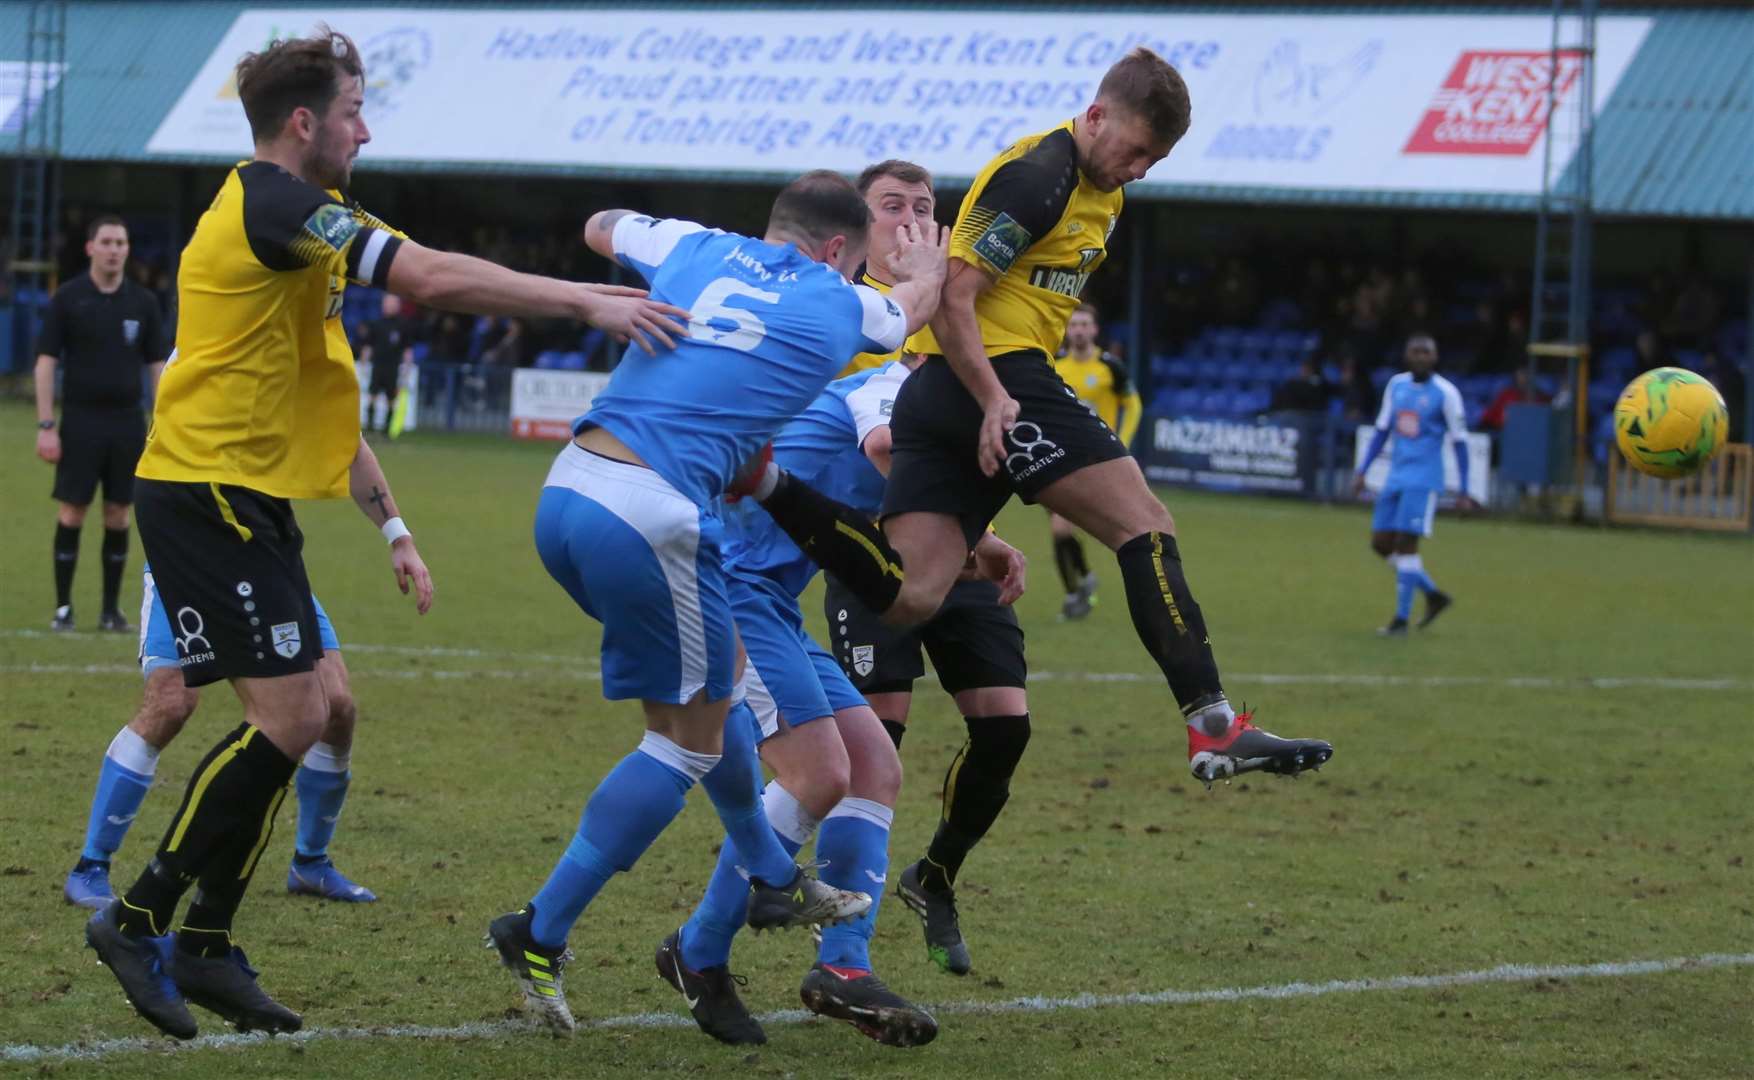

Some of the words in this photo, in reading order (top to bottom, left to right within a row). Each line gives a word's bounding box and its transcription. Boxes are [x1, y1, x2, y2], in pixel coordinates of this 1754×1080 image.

[486, 28, 616, 60] Hadlow
[627, 28, 763, 69] College
[771, 31, 848, 63] and
[852, 30, 953, 65] West
[956, 31, 1057, 66] Kent
[559, 66, 677, 98] Proud
[668, 74, 819, 110] partner
[823, 71, 906, 104] and
[904, 78, 1089, 114] sponsors
[1463, 56, 1584, 88] WEST
[1444, 87, 1564, 122] KENT
[570, 107, 621, 142] of
[624, 108, 812, 153] Tonbridge
[816, 114, 958, 158] Angels
[964, 116, 1027, 150] FC
[1433, 121, 1532, 144] COLLEGE
[688, 277, 781, 352] 6
